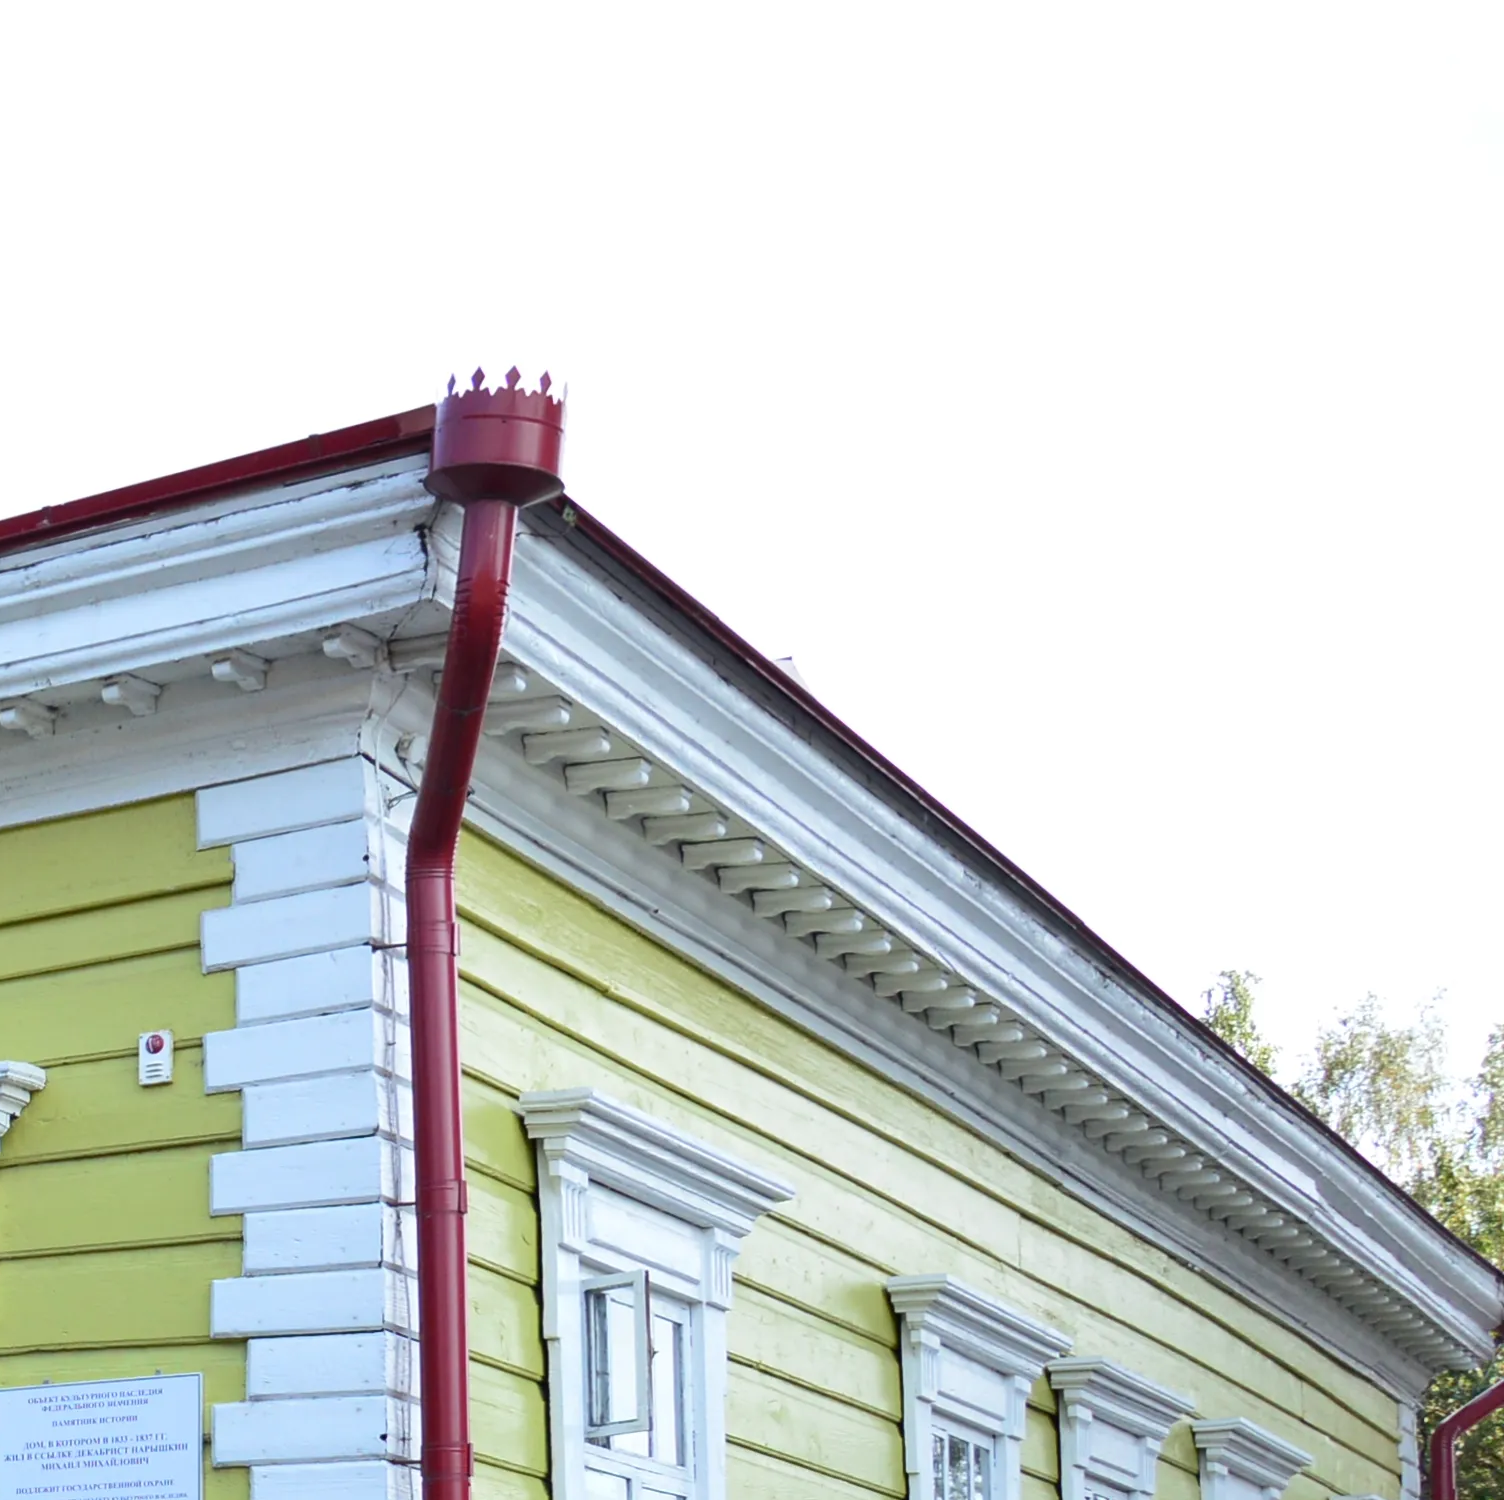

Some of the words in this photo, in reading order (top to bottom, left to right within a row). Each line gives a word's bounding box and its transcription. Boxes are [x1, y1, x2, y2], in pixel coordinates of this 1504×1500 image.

[28, 1396, 58, 1404] ОБЪЕКТ
[61, 1391, 118, 1402] КУЛЬТУРНОГО
[120, 1388, 163, 1398] НАСЛЕДИЯ
[42, 1401, 105, 1412] ФЕДЕРАЛЬНОГО
[107, 1398, 148, 1408] ЗНАЧЕНИЯ
[52, 1418, 97, 1428] ПАМЯТНИК
[100, 1415, 138, 1424] ИСТОРИИ
[56, 1437, 100, 1448] КОТОРОМ
[136, 1433, 153, 1442] 1837
[4, 1453, 25, 1462] ЖИЛ
[34, 1450, 72, 1460] ССЫЛКЕ
[75, 1447, 128, 1458] ДЕКАБРИСТ
[131, 1443, 188, 1454] НАРЫШКИН
[41, 1461, 80, 1471] МИХАИЛ
[83, 1457, 149, 1468] МИХАЙЛОВИЧ
[16, 1485, 60, 1495] ПОДЛЕЖИТ
[62, 1480, 142, 1493] ГОСУДАРСТВЕННОЙ
[143, 1479, 174, 1488] ОХРАНЕ
